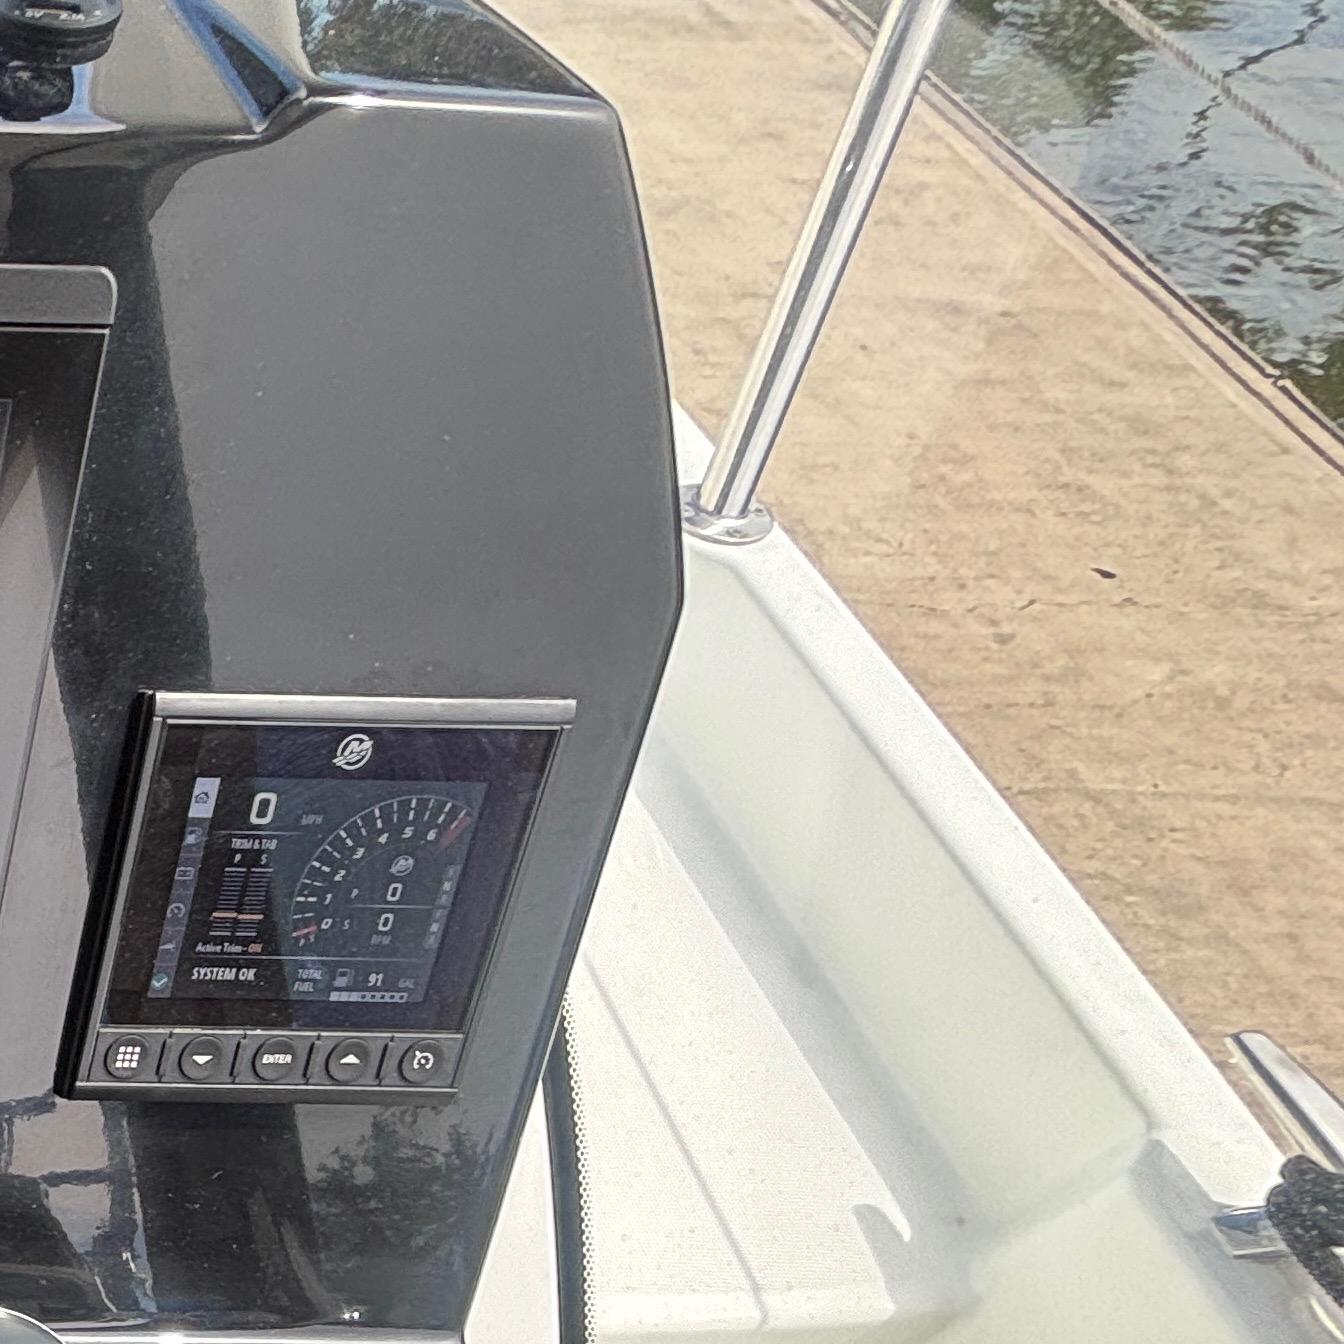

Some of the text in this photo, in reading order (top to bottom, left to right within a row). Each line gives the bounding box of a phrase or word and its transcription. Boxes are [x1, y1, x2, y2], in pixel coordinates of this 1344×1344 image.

[250, 792, 278, 825] 0
[401, 826, 415, 838] 5
[426, 829, 438, 840] 6
[378, 833, 389, 844] 4
[334, 870, 346, 881] 2
[386, 883, 403, 901] 0
[377, 913, 394, 932] 0
[195, 942, 223, 953] Active
[191, 967, 257, 981] SYSTEM OK
[297, 969, 323, 980] TOTAL
[367, 973, 384, 987] 91
[293, 982, 315, 992] FUEL
[261, 1052, 292, 1065] ENTER
